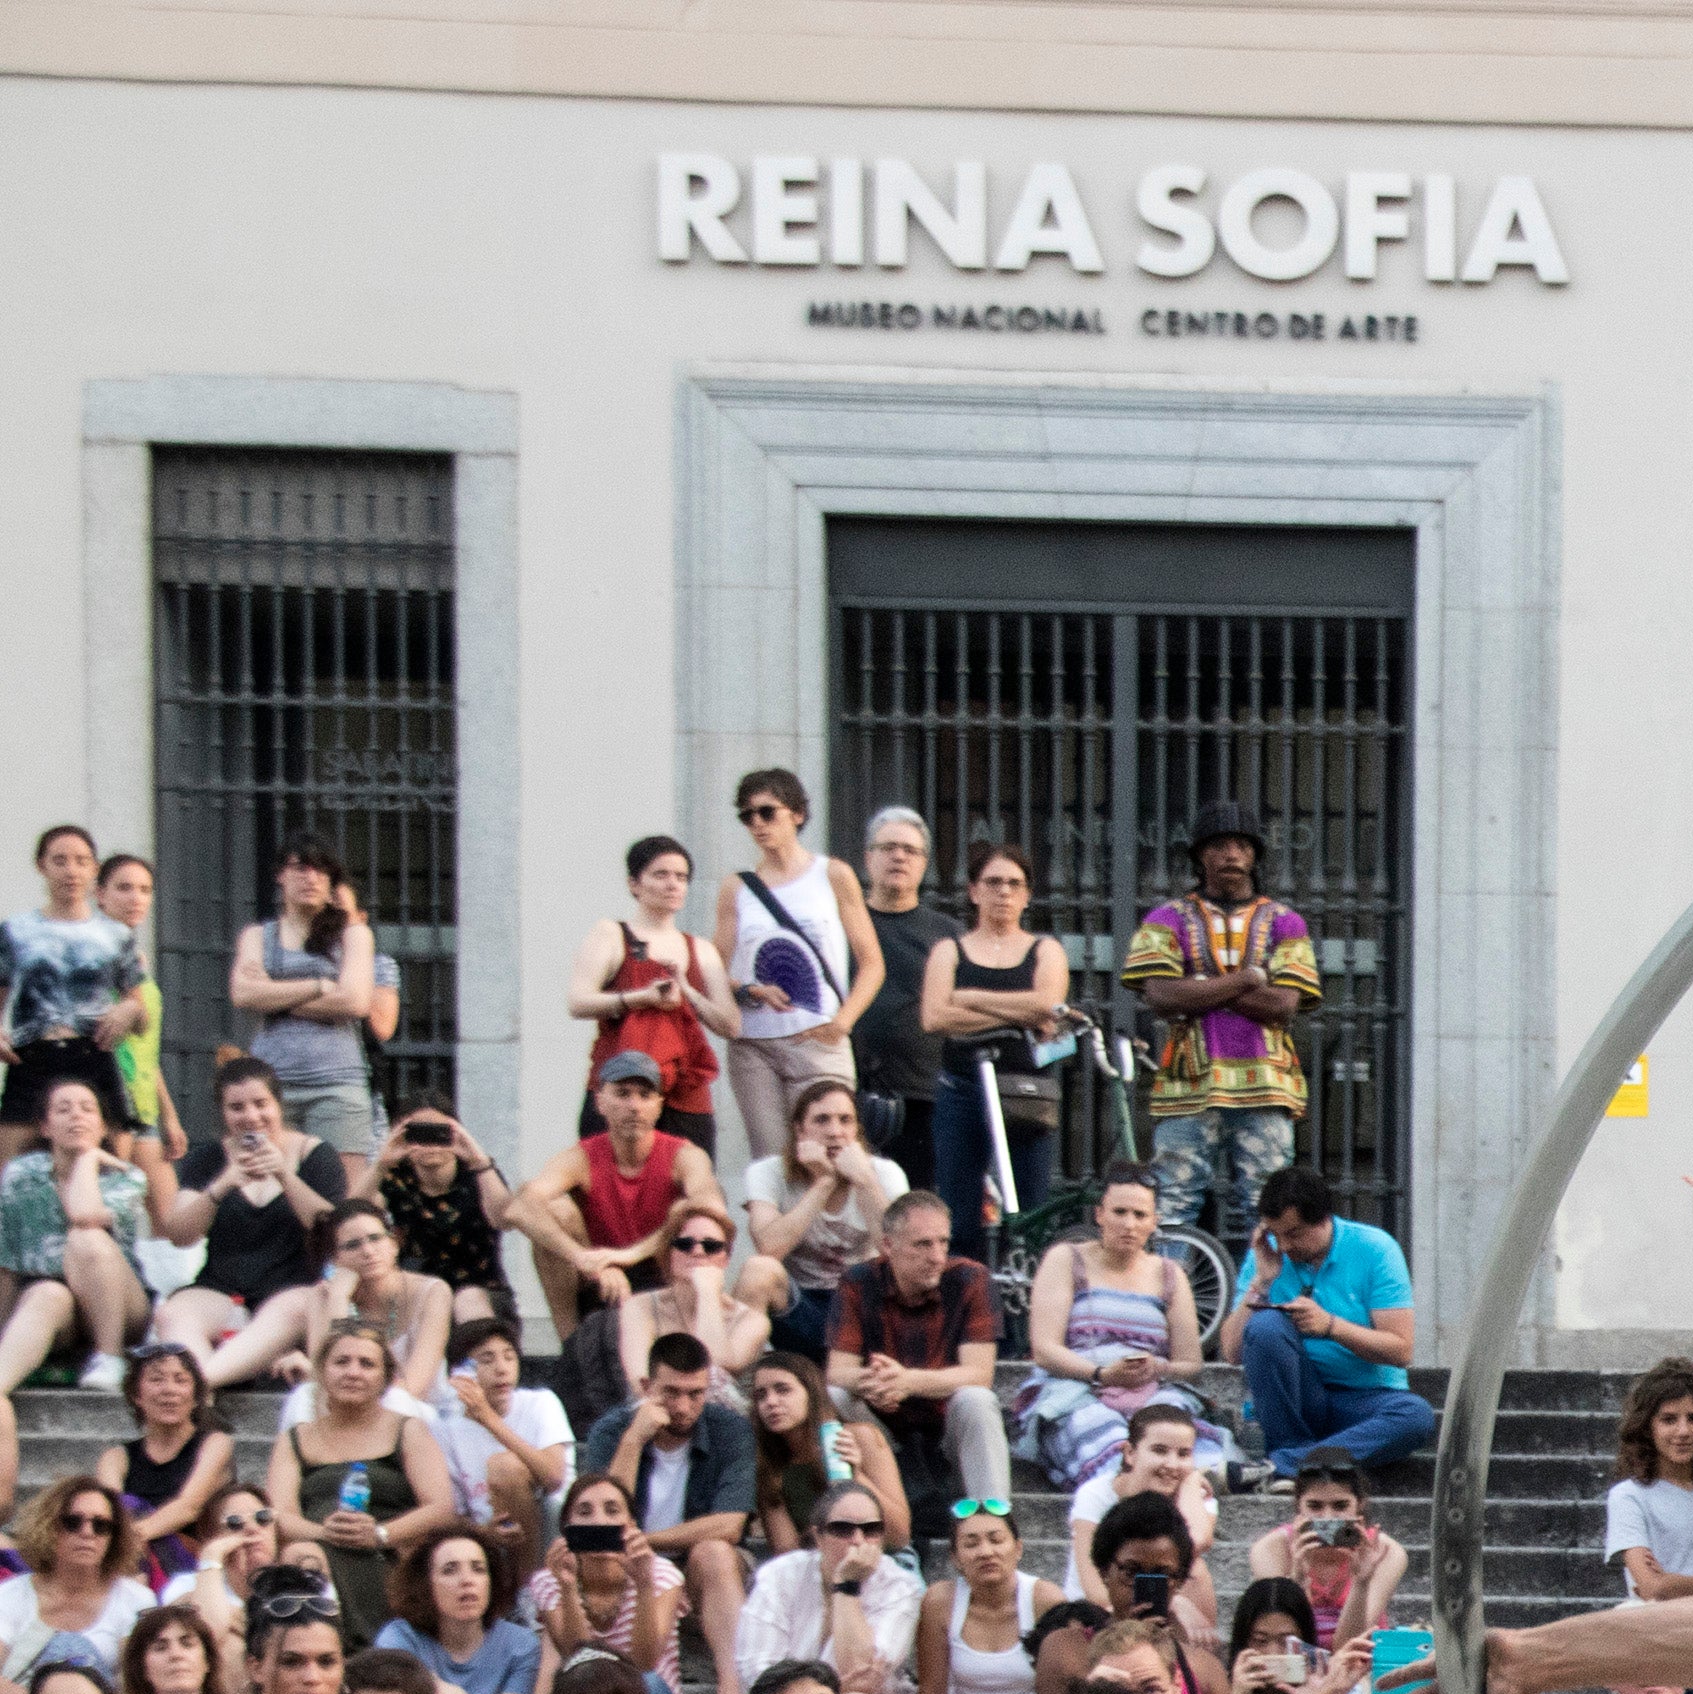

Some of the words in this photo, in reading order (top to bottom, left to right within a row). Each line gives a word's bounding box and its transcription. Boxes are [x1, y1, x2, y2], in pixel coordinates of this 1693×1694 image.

[656, 152, 1105, 274] REINA
[1135, 163, 1572, 285] SOFIA
[806, 302, 921, 333] MUSEO
[930, 305, 1107, 336] NACIONAL
[1140, 309, 1278, 341] CENTRO
[1286, 313, 1327, 341] DE
[1337, 315, 1420, 343] ARTE
